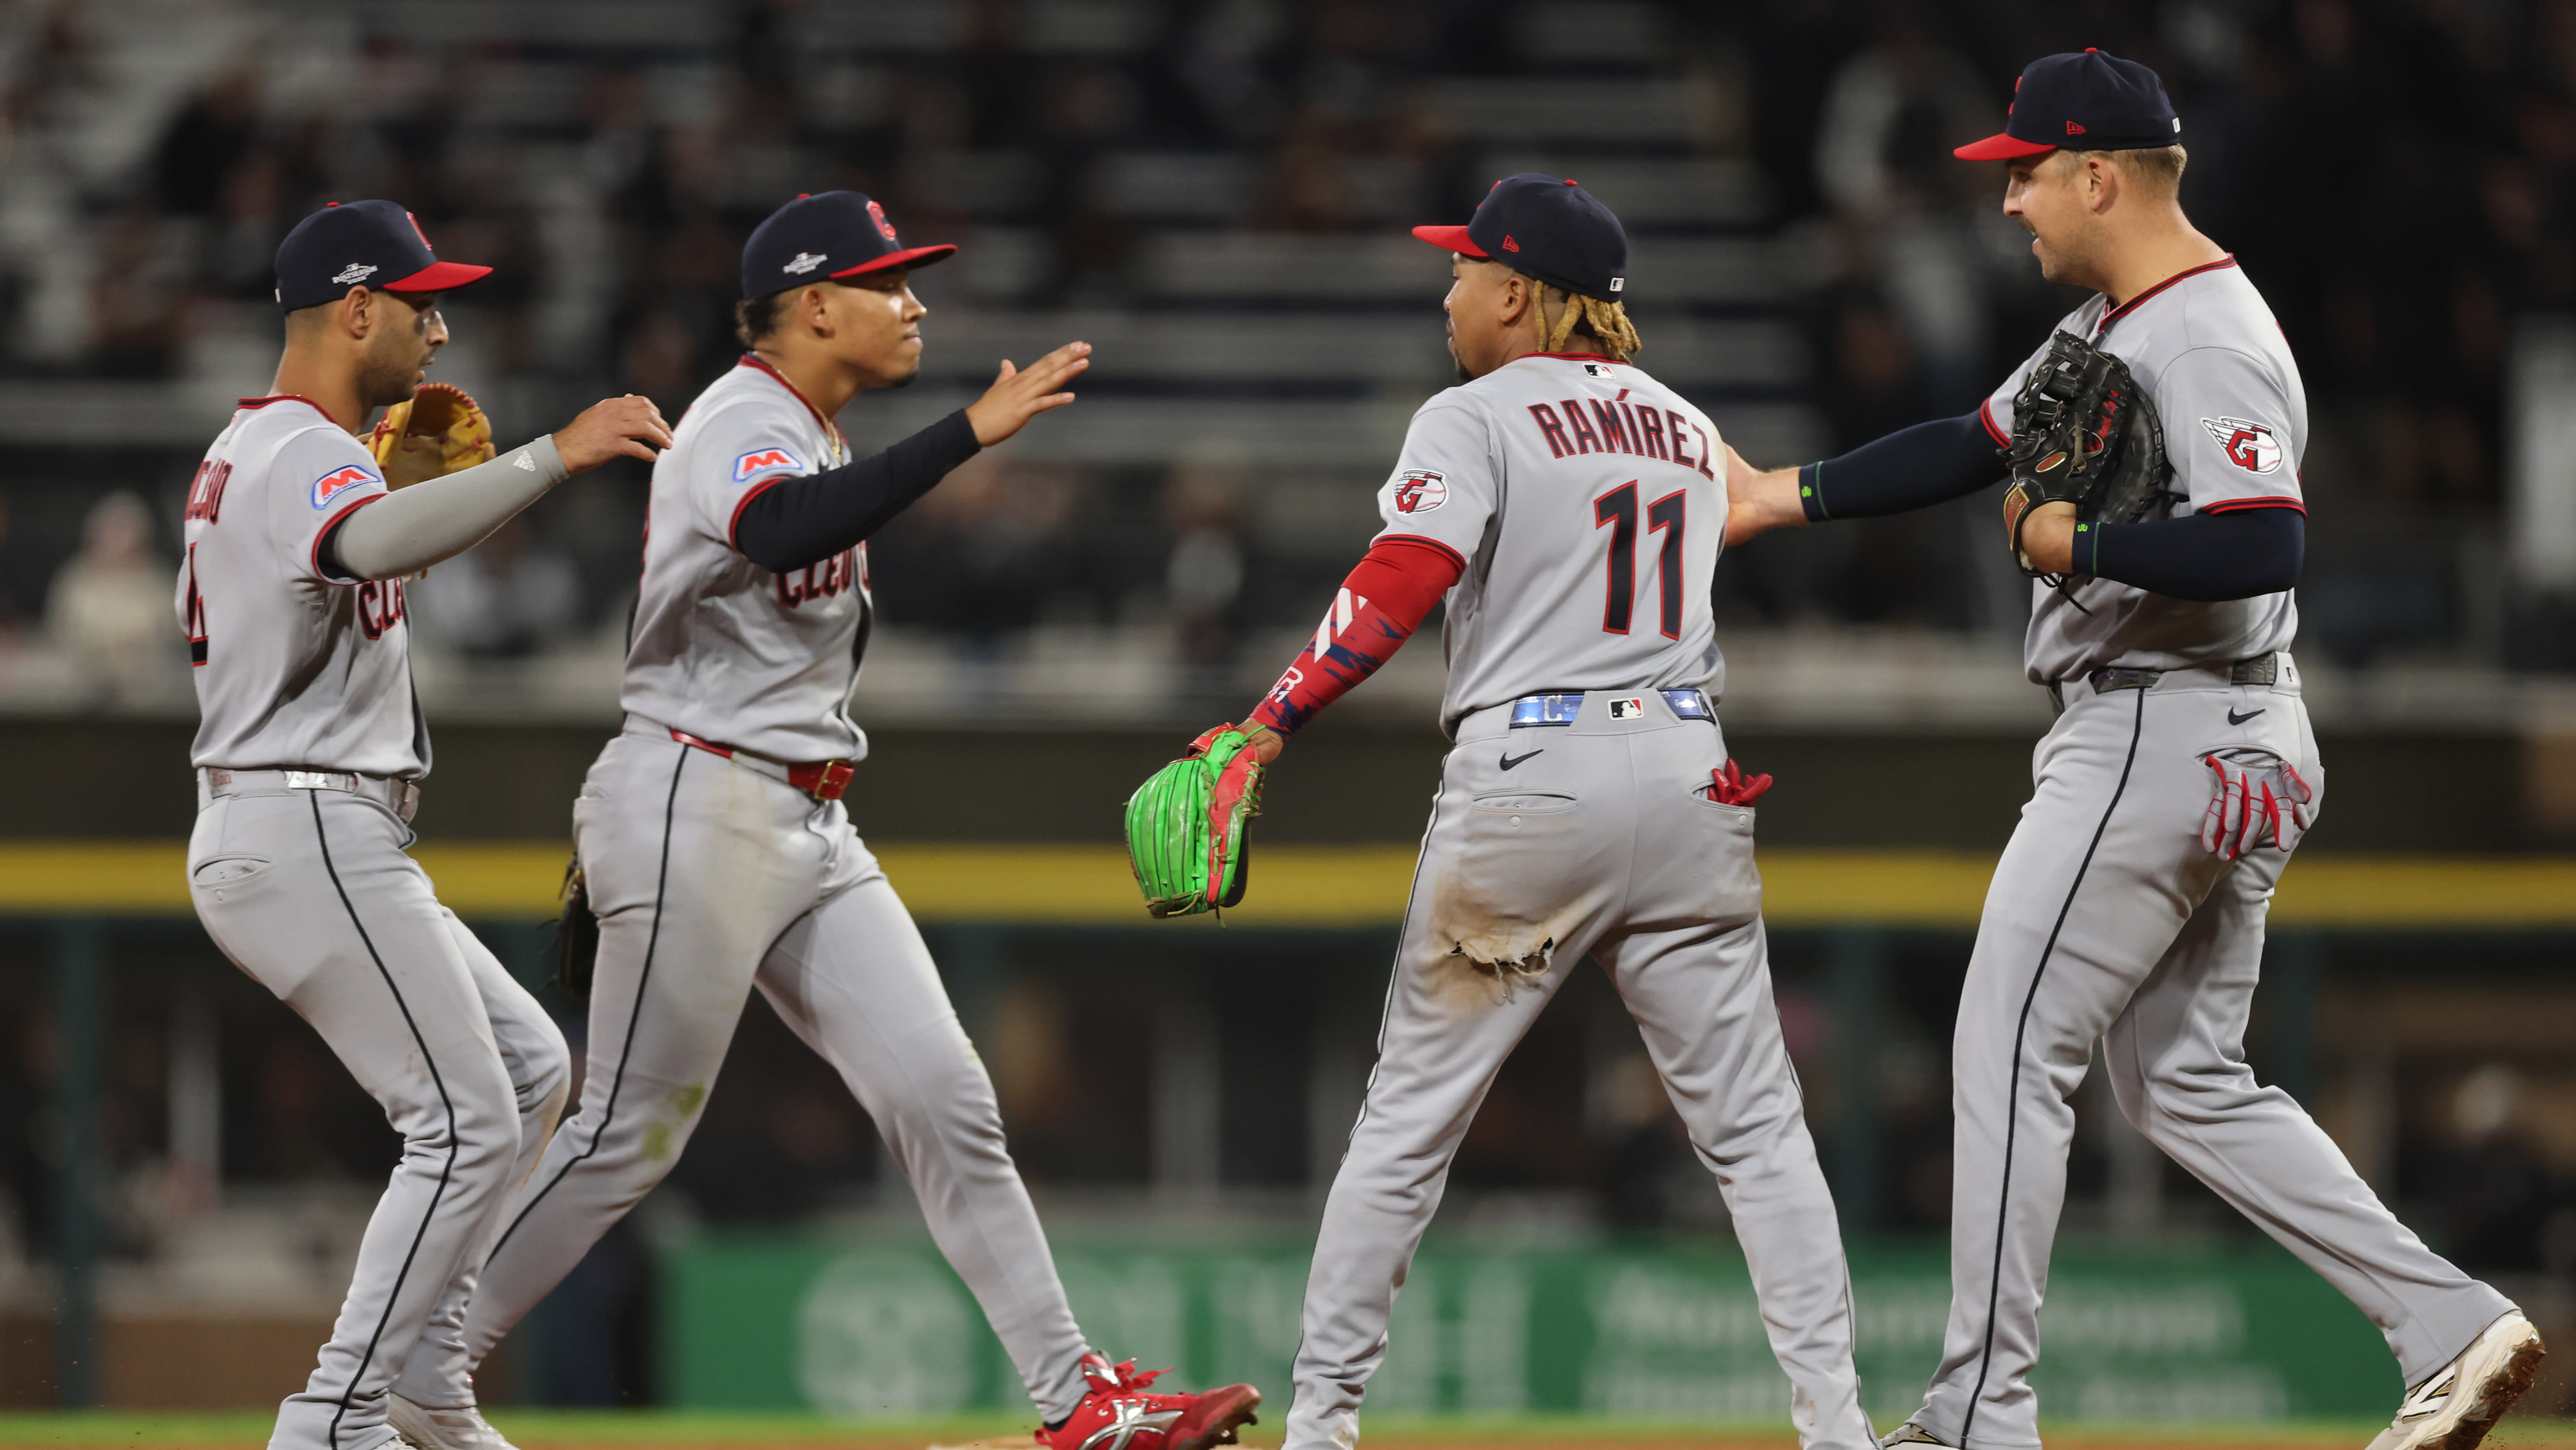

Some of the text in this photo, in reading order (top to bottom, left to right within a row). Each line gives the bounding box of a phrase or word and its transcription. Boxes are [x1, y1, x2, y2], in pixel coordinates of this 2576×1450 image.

[1527, 389, 1714, 480] RAMÍREZ
[1594, 479, 1686, 641] 11
[1544, 695, 1563, 722] C
